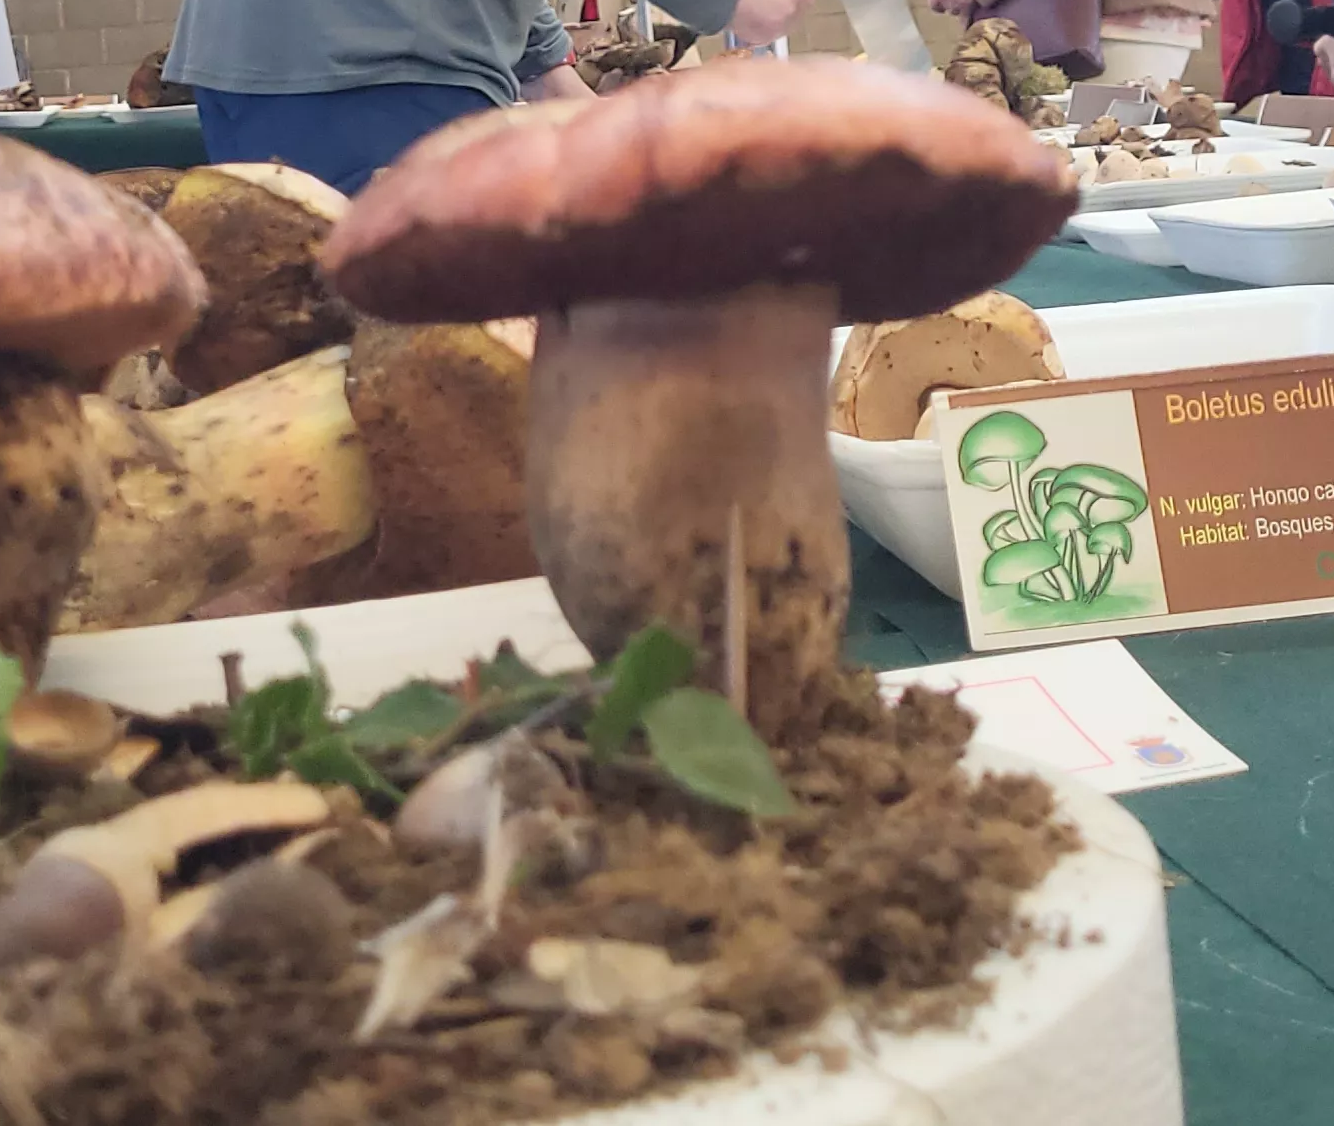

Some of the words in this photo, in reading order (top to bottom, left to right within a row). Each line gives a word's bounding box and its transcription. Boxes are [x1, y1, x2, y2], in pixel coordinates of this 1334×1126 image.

[1165, 389, 1265, 425] Boletus
[1159, 495, 1181, 518] N.
[1185, 492, 1246, 517] vulgar:
[1249, 486, 1310, 508] Hongo
[1180, 521, 1250, 548] Habitat:
